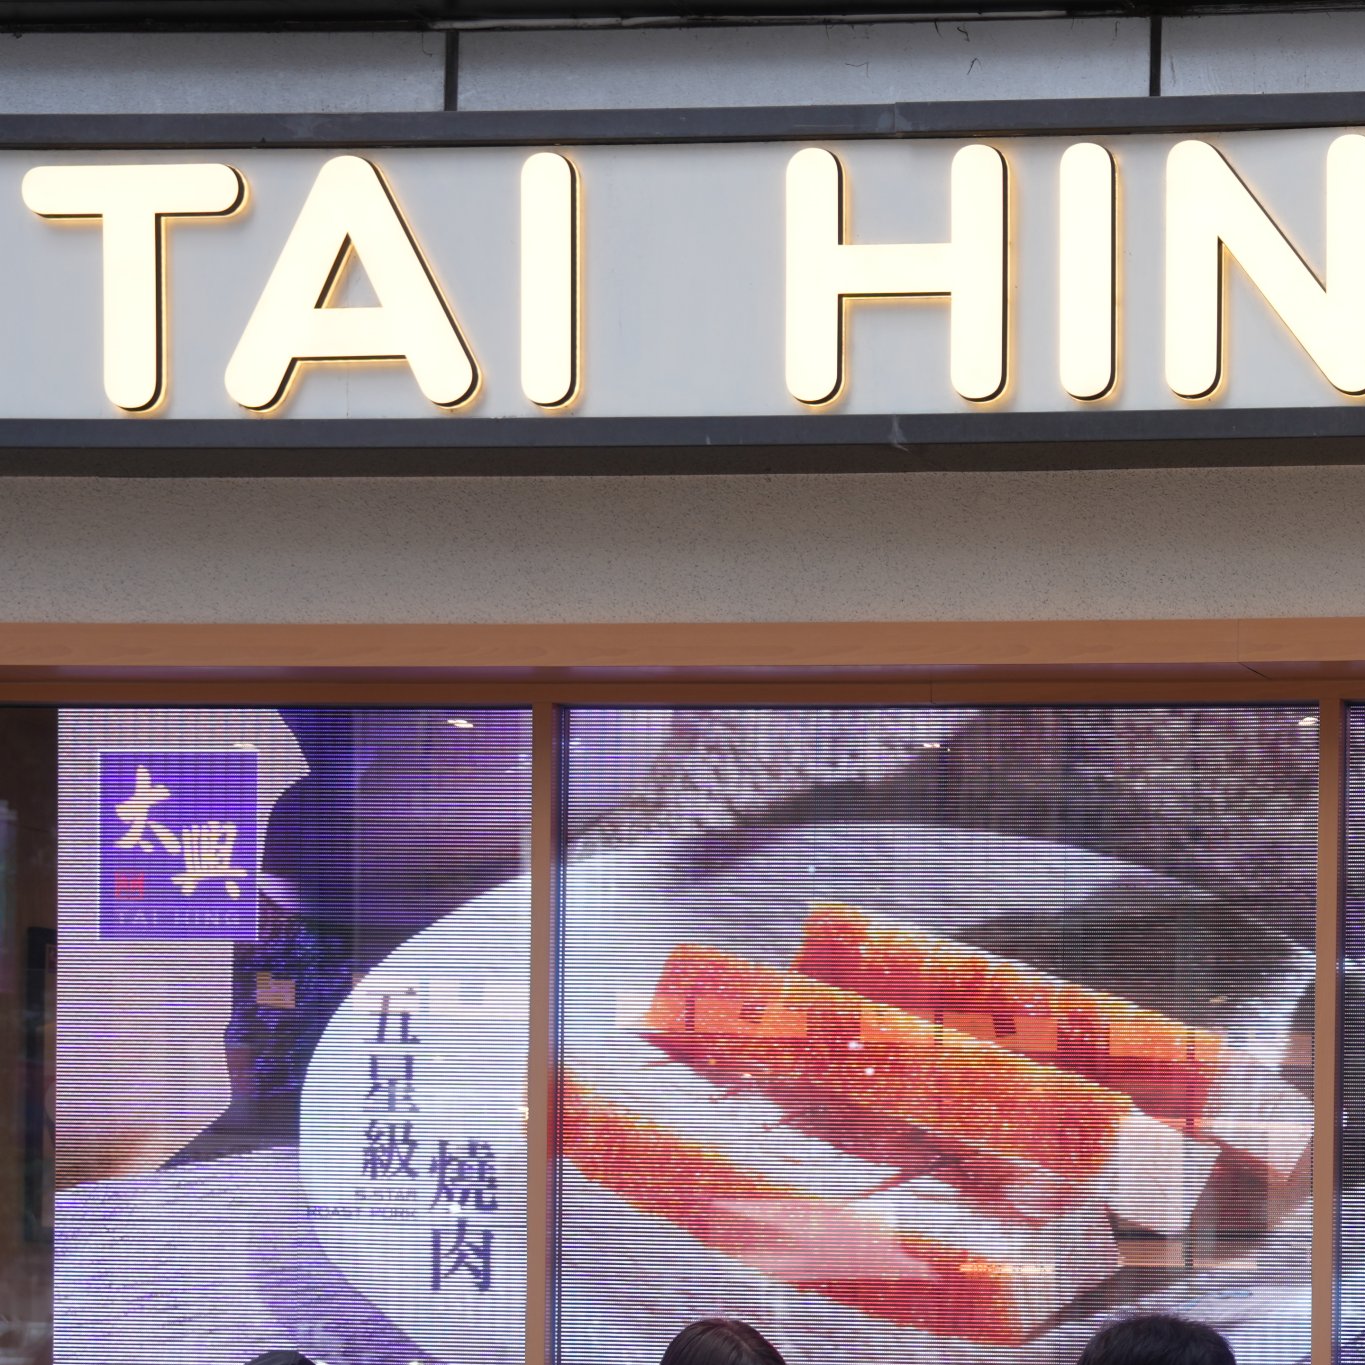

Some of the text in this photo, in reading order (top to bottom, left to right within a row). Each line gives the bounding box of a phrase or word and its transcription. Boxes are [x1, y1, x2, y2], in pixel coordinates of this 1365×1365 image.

[21, 150, 583, 412] TAI
[112, 764, 249, 899] 太興
[362, 988, 420, 1181] 五星級
[429, 1136, 499, 1292] 燒肉
